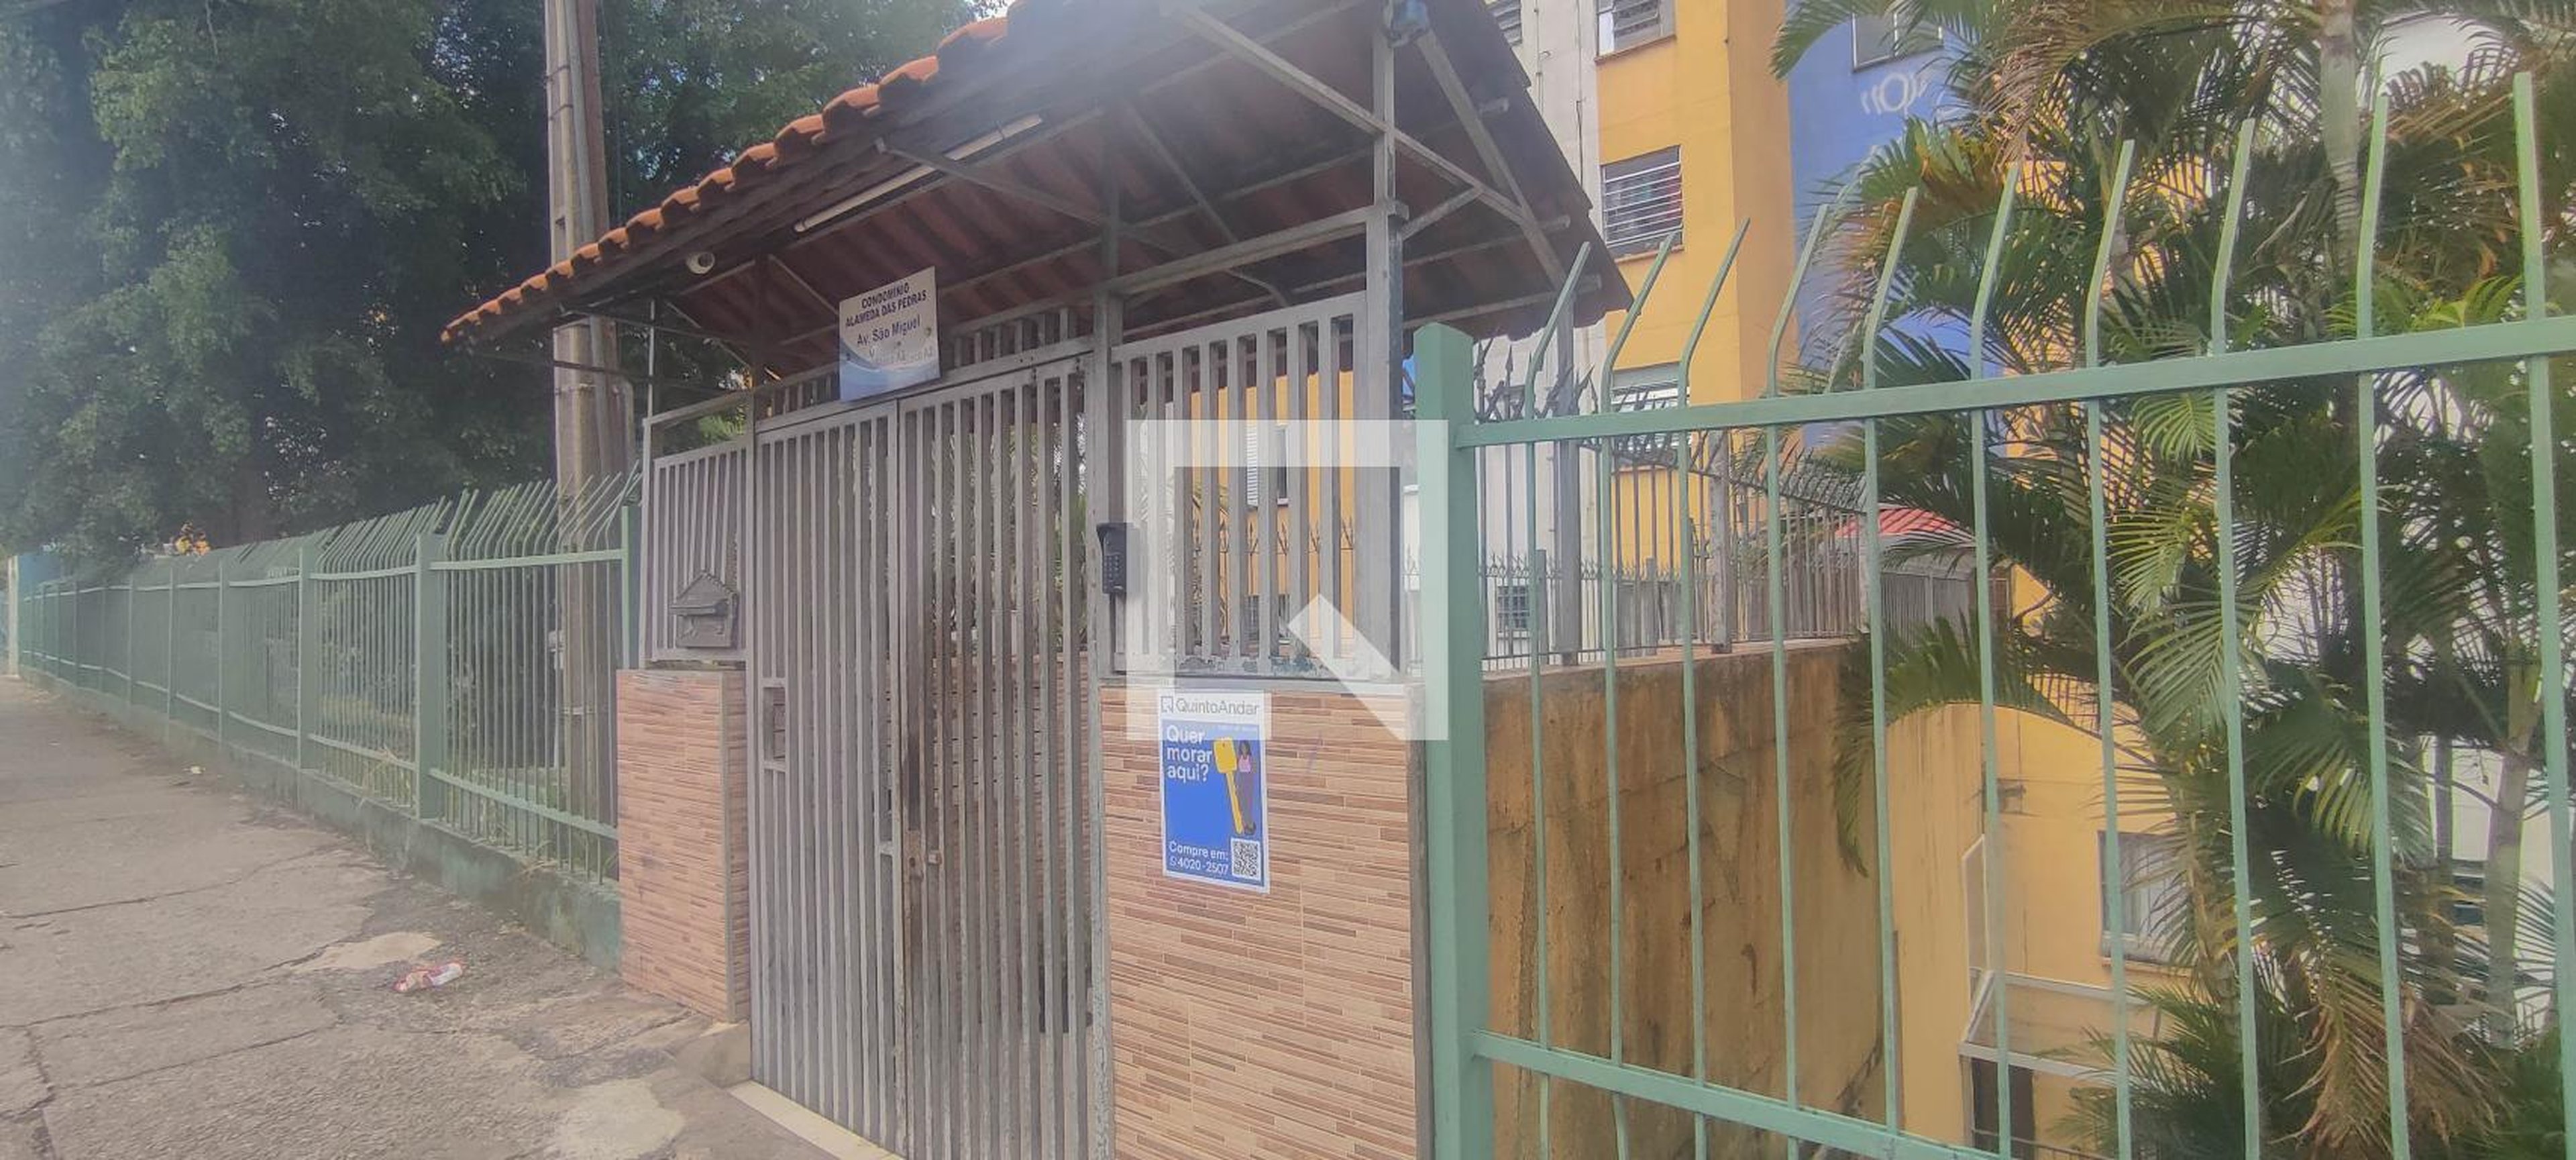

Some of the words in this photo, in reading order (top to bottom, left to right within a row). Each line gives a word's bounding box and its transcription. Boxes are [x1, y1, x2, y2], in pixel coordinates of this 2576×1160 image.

[846, 309, 879, 327] ALAMEDA
[881, 302, 896, 315] DAS
[898, 290, 926, 310] PEDRAS
[857, 333, 871, 346] Av.
[872, 327, 890, 342] São
[892, 314, 920, 336] Miguel
[1175, 697, 1260, 715] QuintoAndar
[1166, 724, 1206, 745] Quer
[1167, 746, 1212, 764] morar
[1167, 763, 1209, 783] aqui?
[1169, 840, 1208, 859] Compre
[1210, 848, 1230, 860] em:
